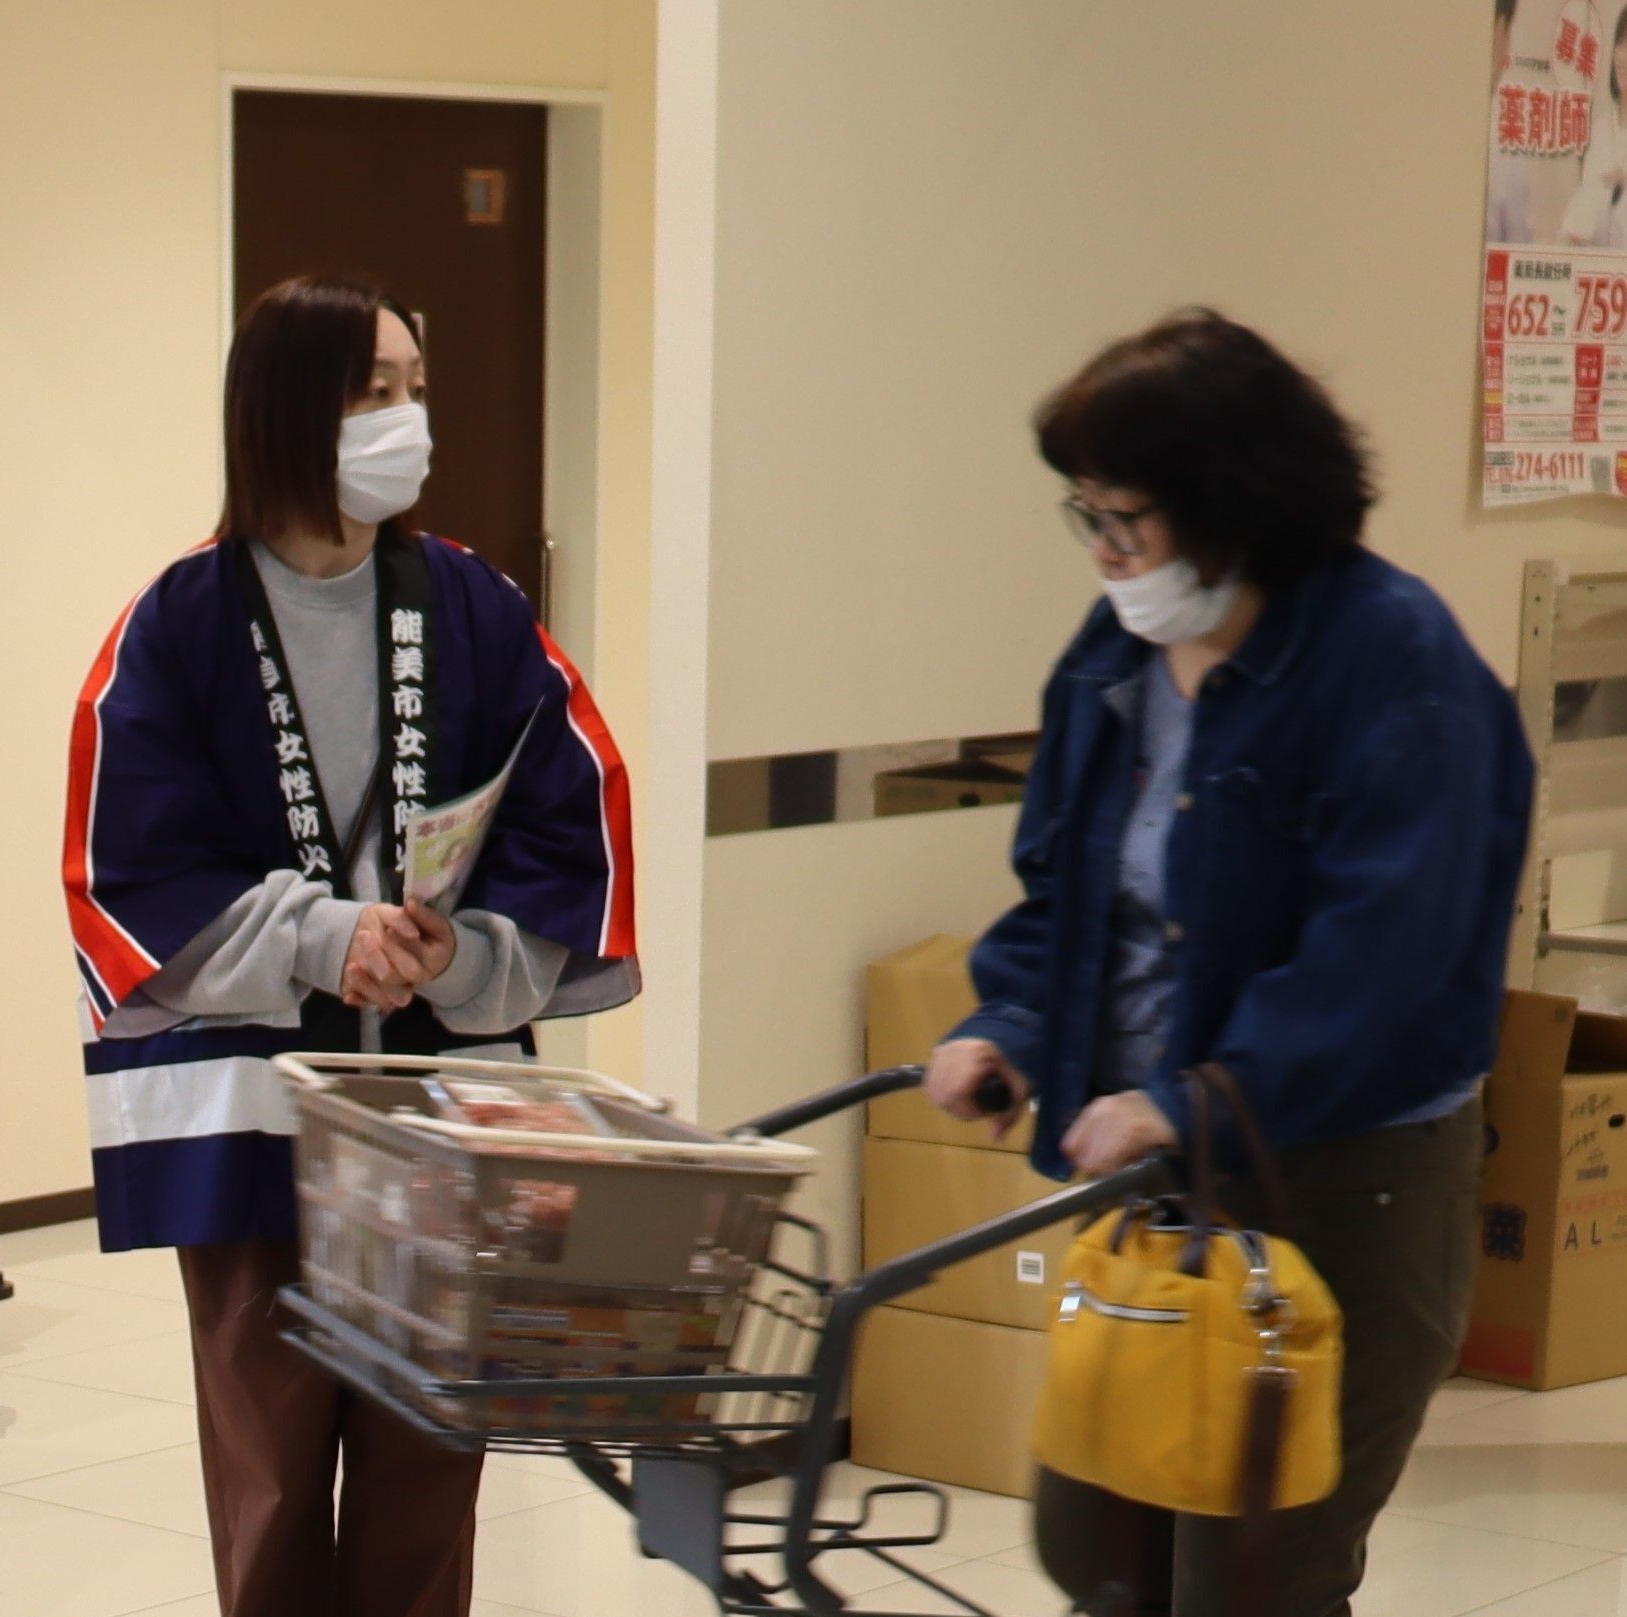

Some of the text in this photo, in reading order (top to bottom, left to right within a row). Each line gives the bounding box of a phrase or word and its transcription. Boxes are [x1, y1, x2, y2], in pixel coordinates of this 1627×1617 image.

[1498, 85, 1590, 150] 薬剤師
[1508, 277, 1627, 336] 652 759
